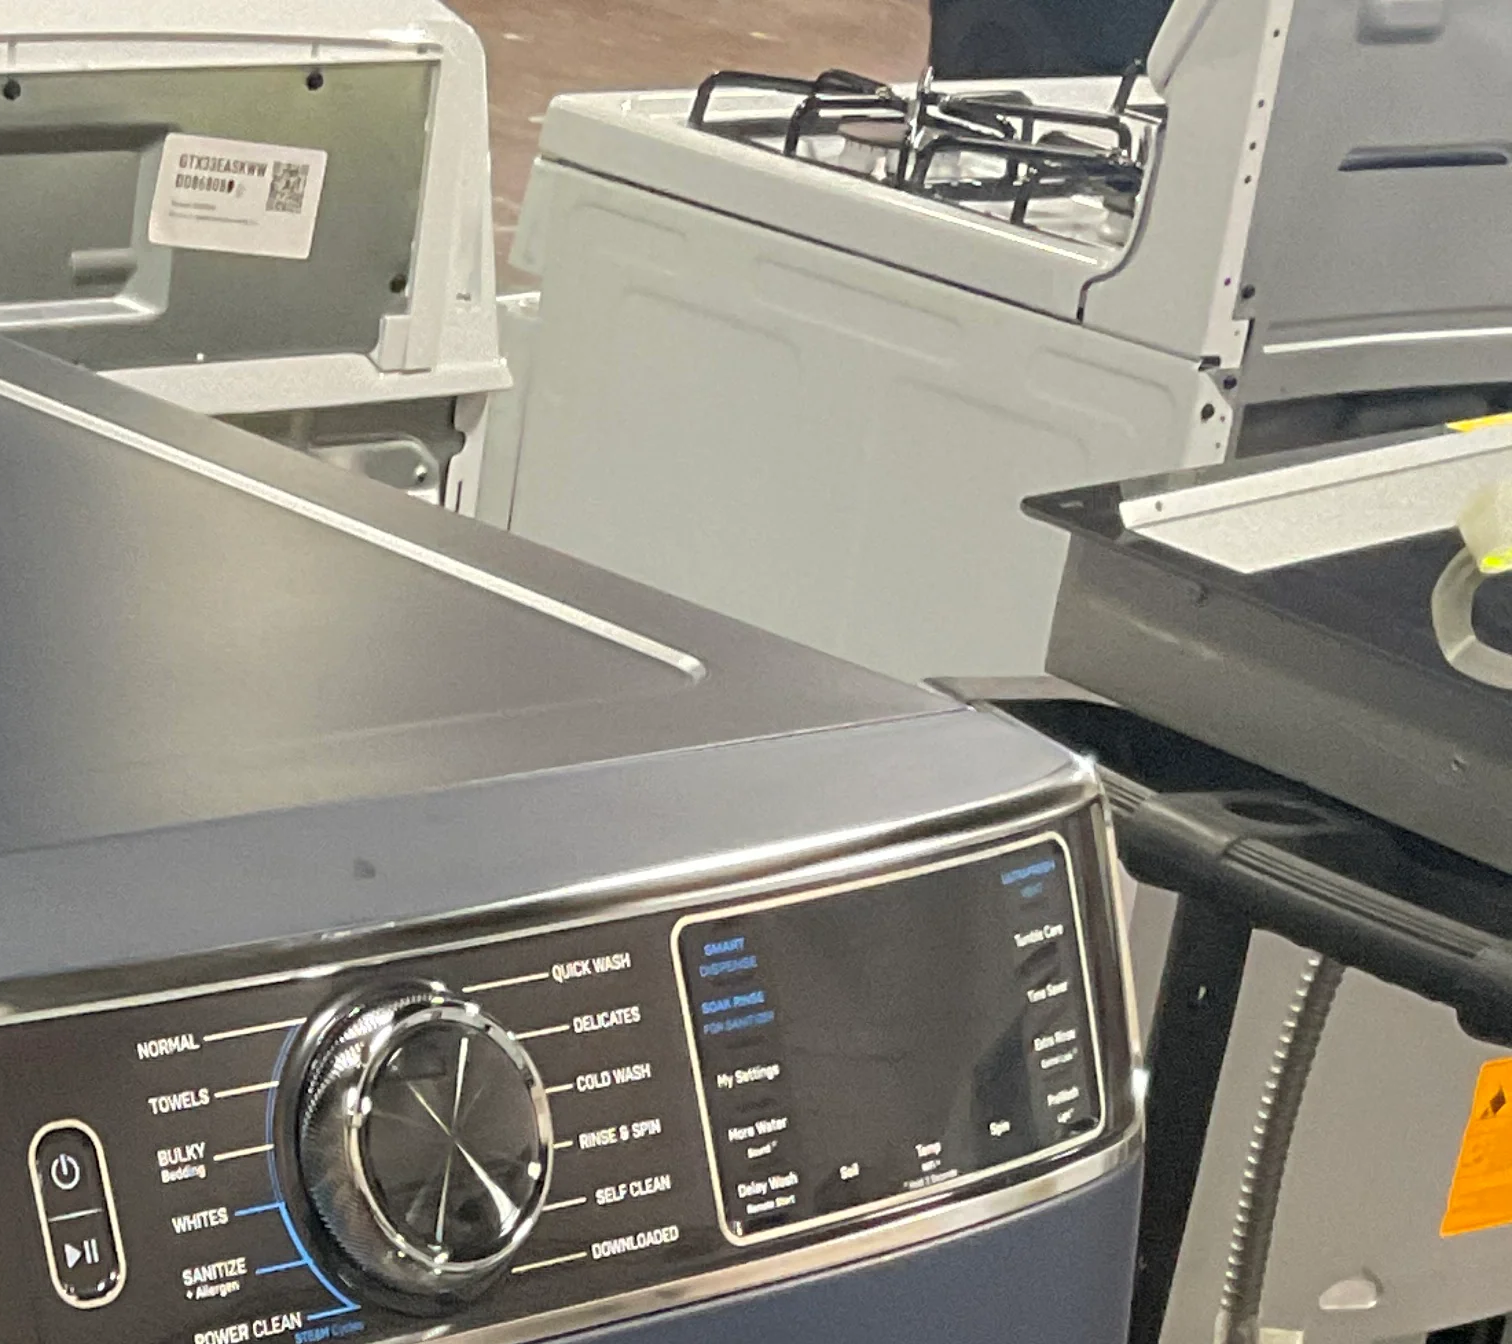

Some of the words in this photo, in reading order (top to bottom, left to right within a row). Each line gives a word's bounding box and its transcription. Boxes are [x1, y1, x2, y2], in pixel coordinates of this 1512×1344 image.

[551, 959, 591, 983] QUICK
[592, 952, 632, 973] WASH
[572, 1006, 641, 1033] DELICATES
[136, 1033, 200, 1060] NORMAL
[576, 1071, 611, 1092] COLD
[612, 1063, 652, 1084] WASH
[716, 1073, 735, 1089] My
[734, 1064, 781, 1084] Settings
[148, 1087, 210, 1115] TOWELS
[579, 1127, 617, 1149] RINSE
[631, 1118, 662, 1139] SPIN
[728, 1126, 755, 1142] More
[755, 1117, 788, 1135] Water
[157, 1141, 206, 1167] BULKY
[161, 1164, 206, 1183] Bedding
[737, 1181, 768, 1198] Delay
[768, 1171, 799, 1190] Wash
[595, 1184, 627, 1205] SELF
[629, 1174, 671, 1197] CLEAN
[171, 1206, 229, 1234] WHITES
[591, 1225, 679, 1260] DOWNLOADED
[182, 1257, 247, 1287] SANITIZE
[196, 1280, 240, 1299] Allergen
[252, 1312, 303, 1338] CLEAN
[294, 1326, 330, 1344] STEAM
